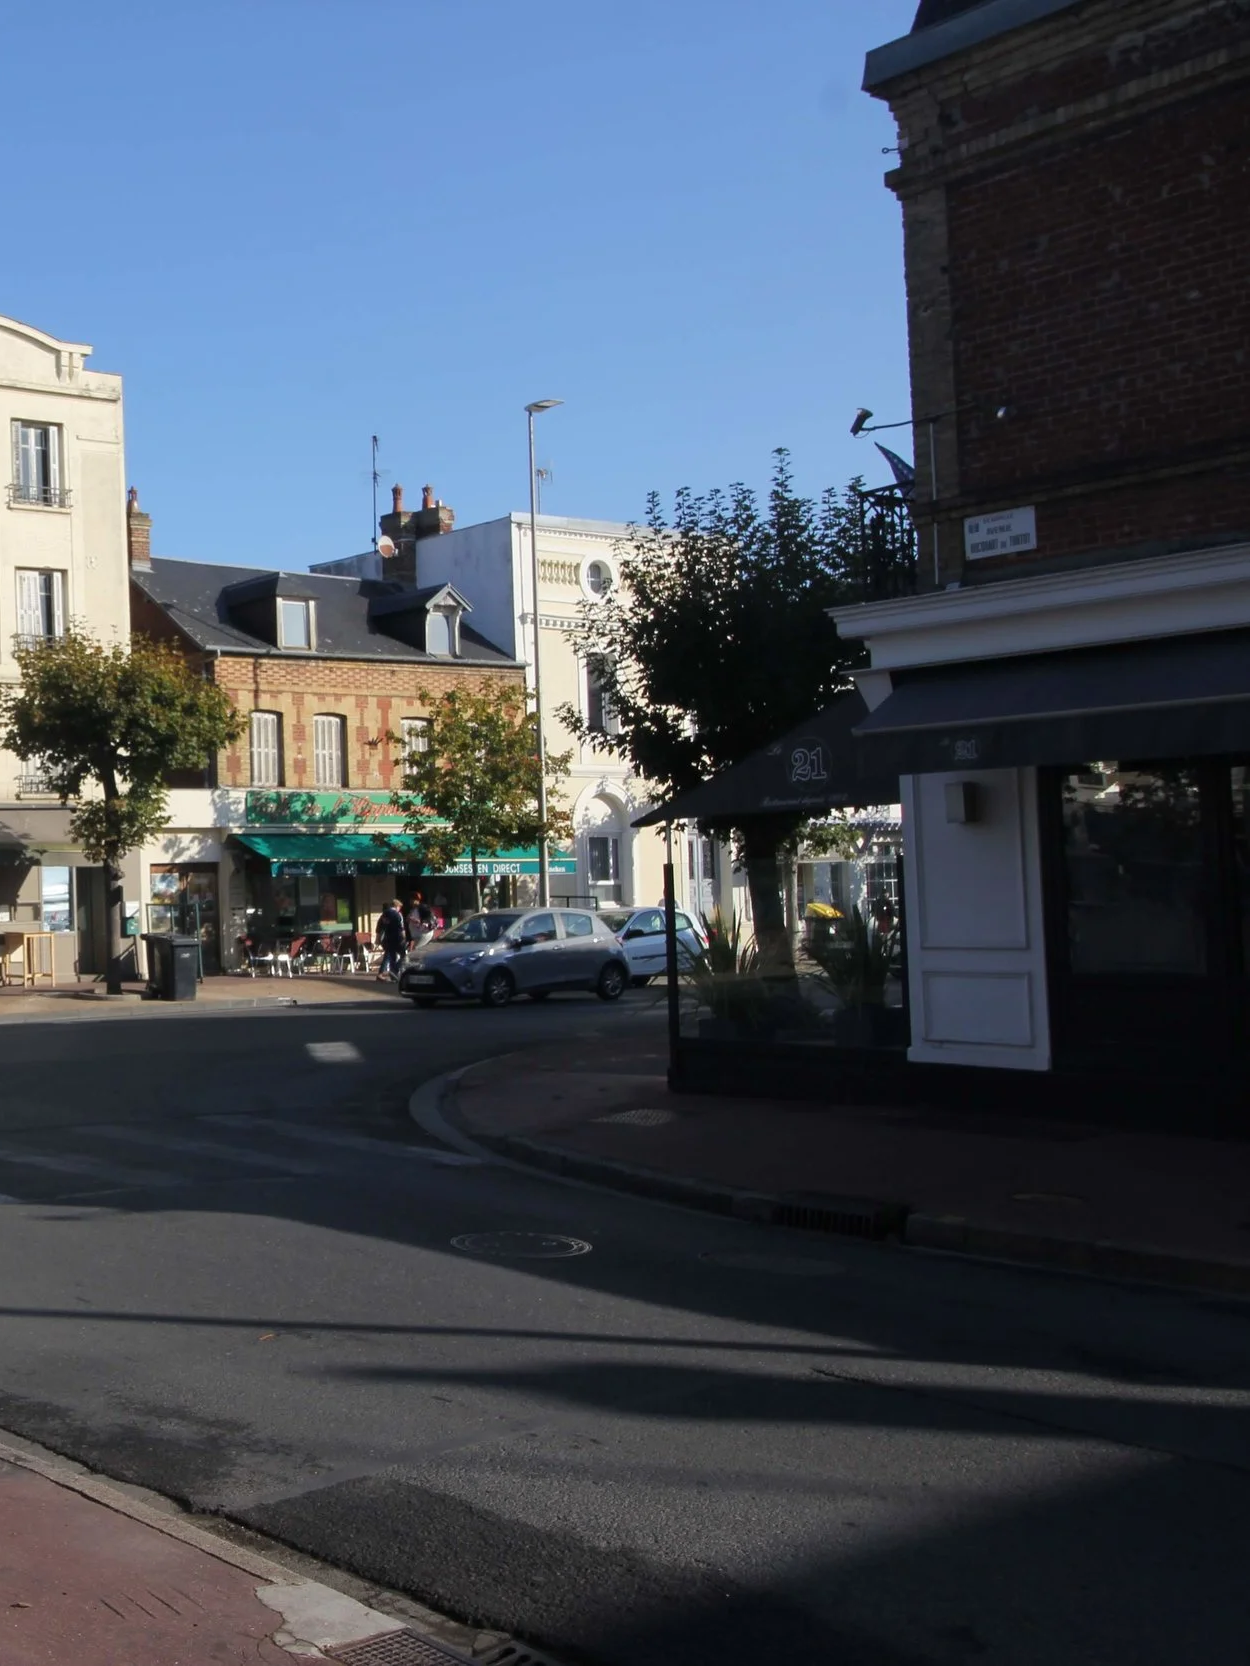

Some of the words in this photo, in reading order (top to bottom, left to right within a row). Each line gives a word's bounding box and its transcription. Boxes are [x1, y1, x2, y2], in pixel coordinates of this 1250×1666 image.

[954, 739, 979, 761] 21
[791, 746, 827, 782] 21
[477, 864, 488, 873] EN
[493, 863, 520, 874] DIRECT
